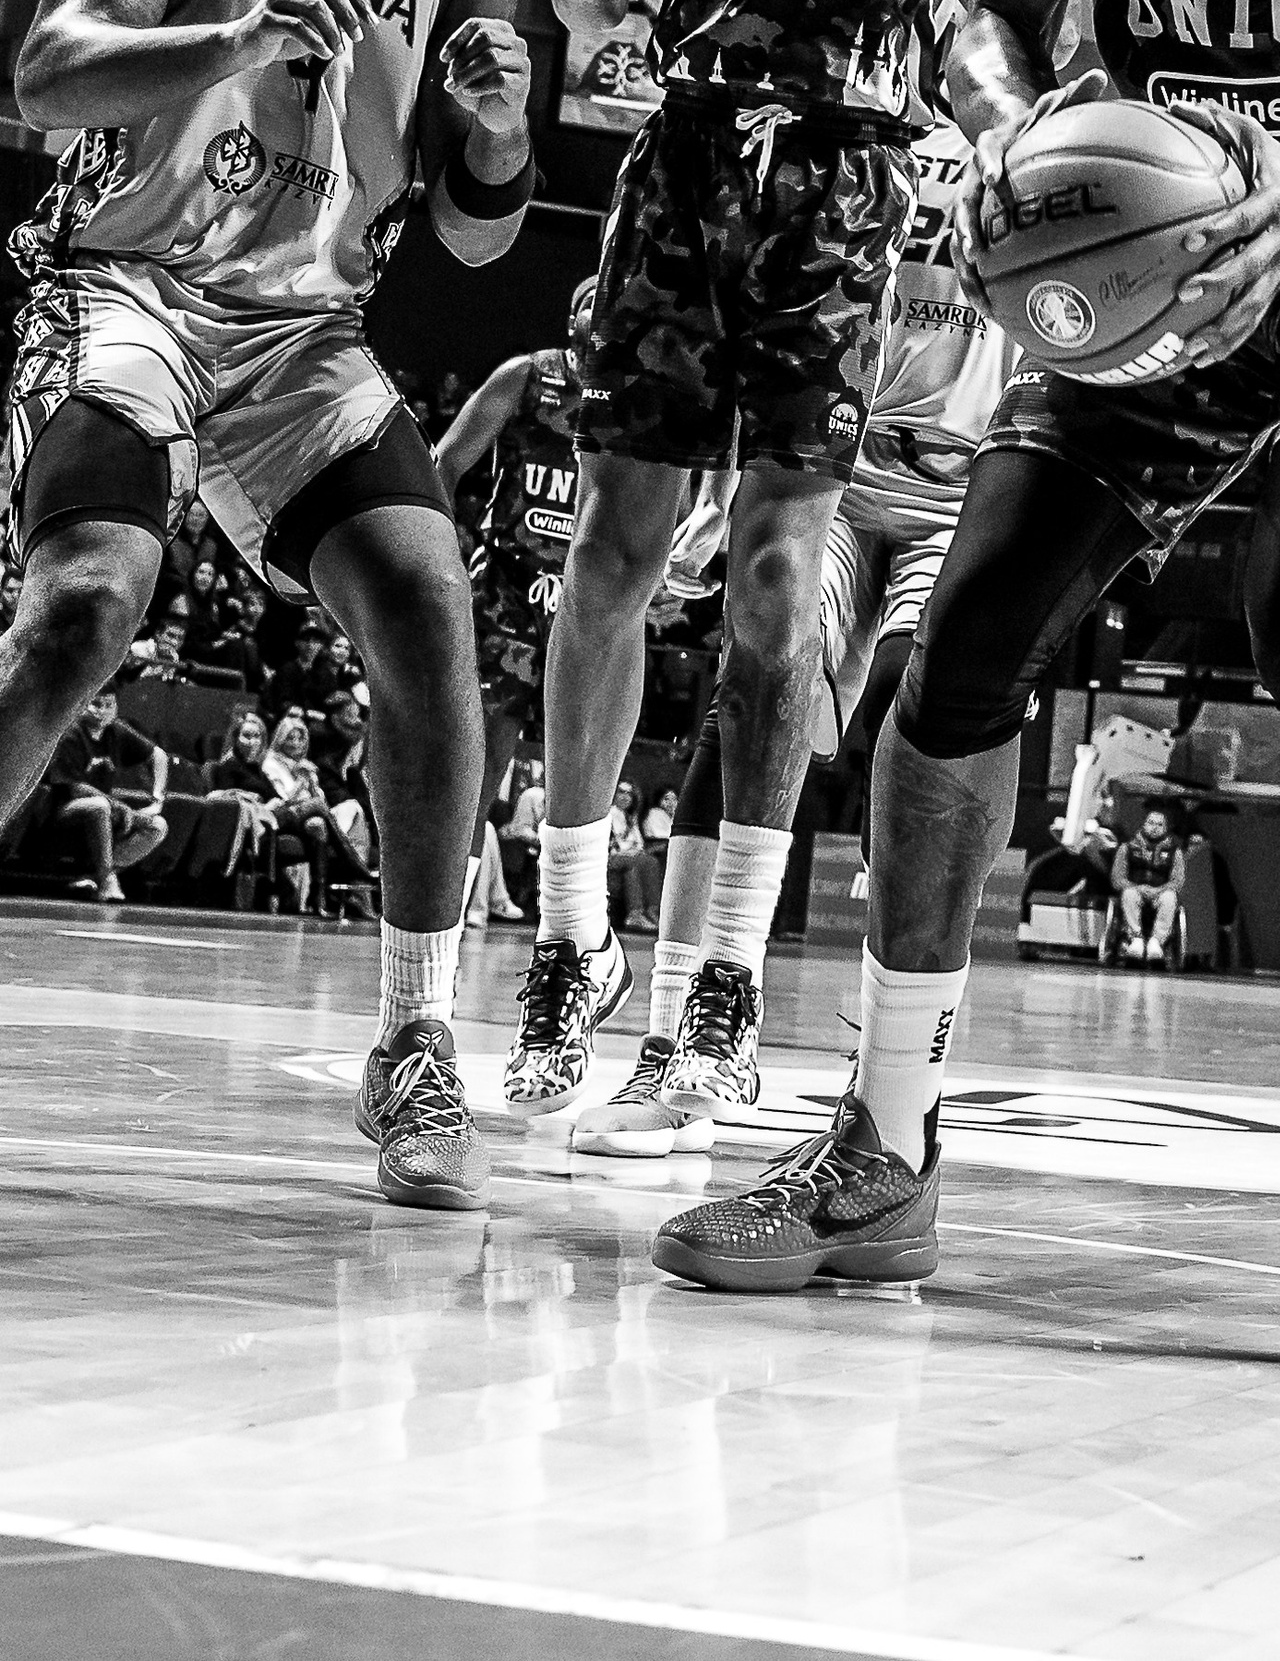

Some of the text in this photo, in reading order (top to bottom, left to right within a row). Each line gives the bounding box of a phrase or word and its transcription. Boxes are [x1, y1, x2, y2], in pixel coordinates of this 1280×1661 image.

[906, 299, 987, 331] SAMRUK
[828, 417, 859, 436] UNICS
[928, 1006, 956, 1065] MAXX
